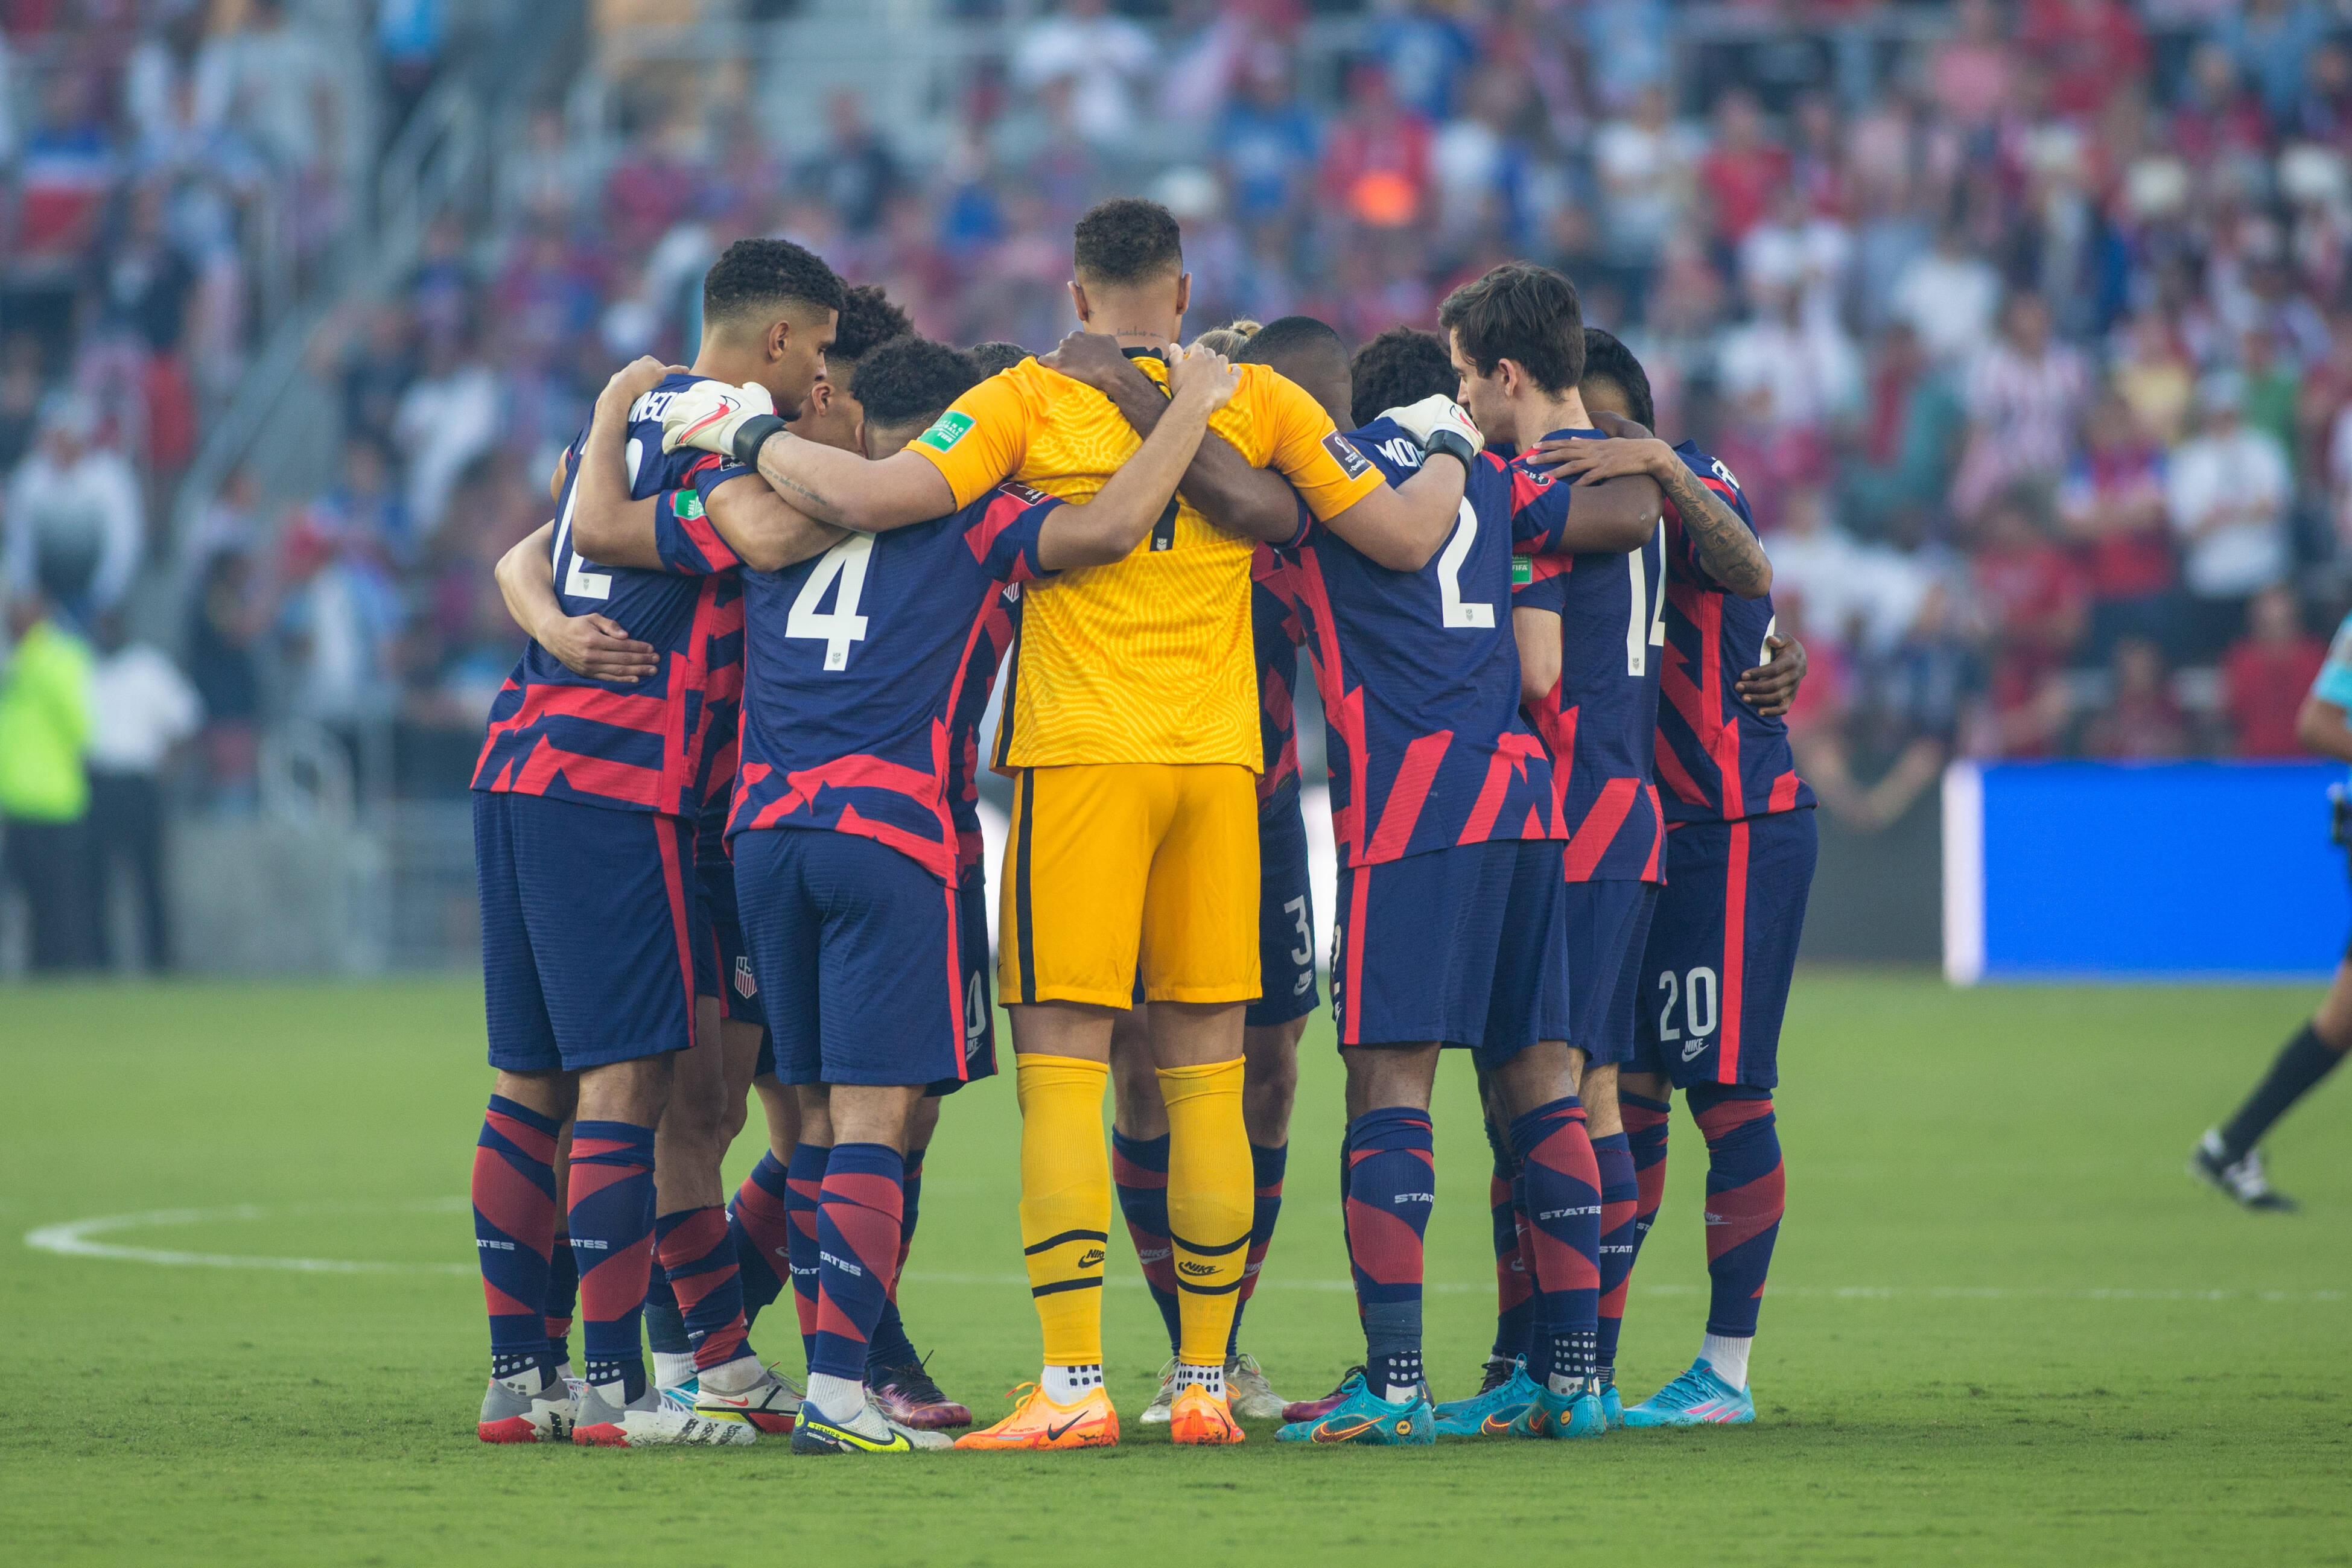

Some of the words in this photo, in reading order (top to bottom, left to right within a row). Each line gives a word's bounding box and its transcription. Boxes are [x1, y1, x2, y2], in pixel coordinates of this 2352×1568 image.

[1437, 495, 1496, 628] 2
[784, 530, 876, 671] 4
[1283, 894, 1312, 965] 3
[1659, 967, 1717, 1042] 20
[1684, 1038, 1704, 1053] NIKE
[1539, 1205, 1601, 1220] STATES
[1184, 1261, 1216, 1274] NIKE
